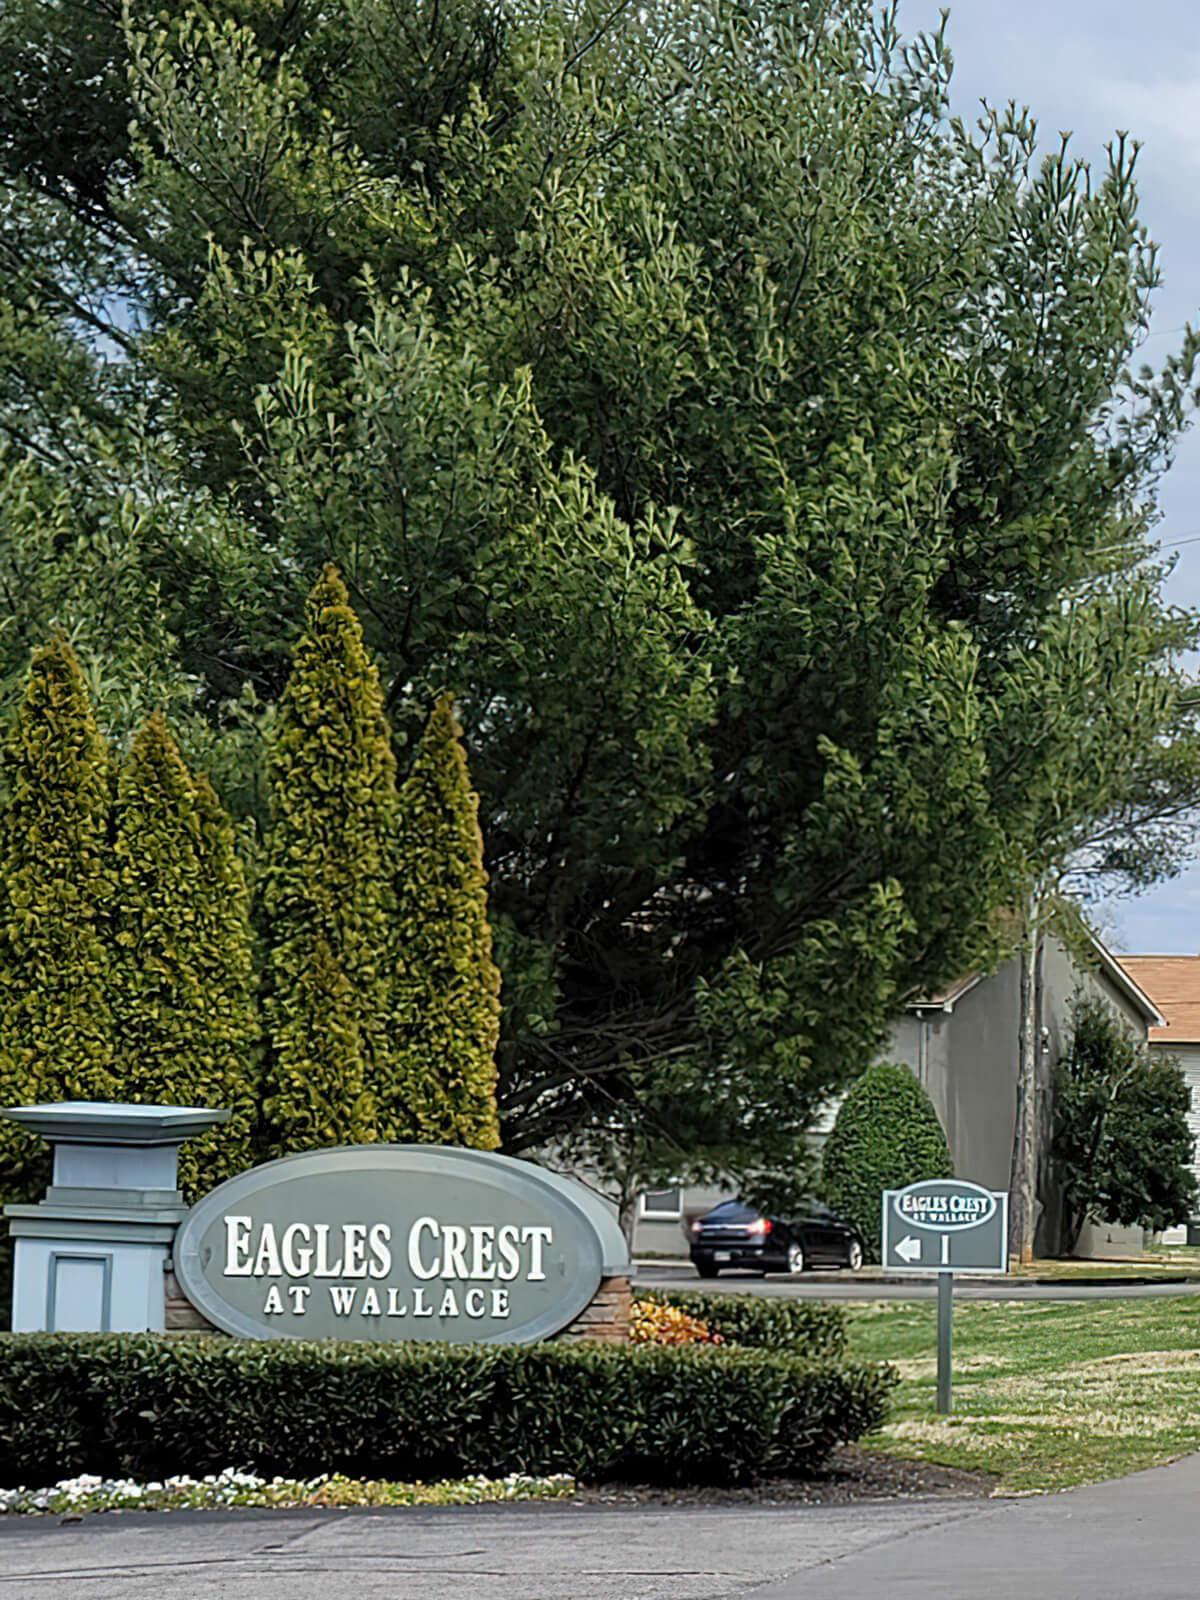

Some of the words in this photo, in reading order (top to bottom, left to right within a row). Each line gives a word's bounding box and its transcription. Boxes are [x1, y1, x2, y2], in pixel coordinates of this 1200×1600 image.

[223, 1216, 392, 1279] EAGLES
[408, 1217, 552, 1282] CREST
[263, 1286, 311, 1314] AT
[329, 1286, 511, 1317] WALLACE
